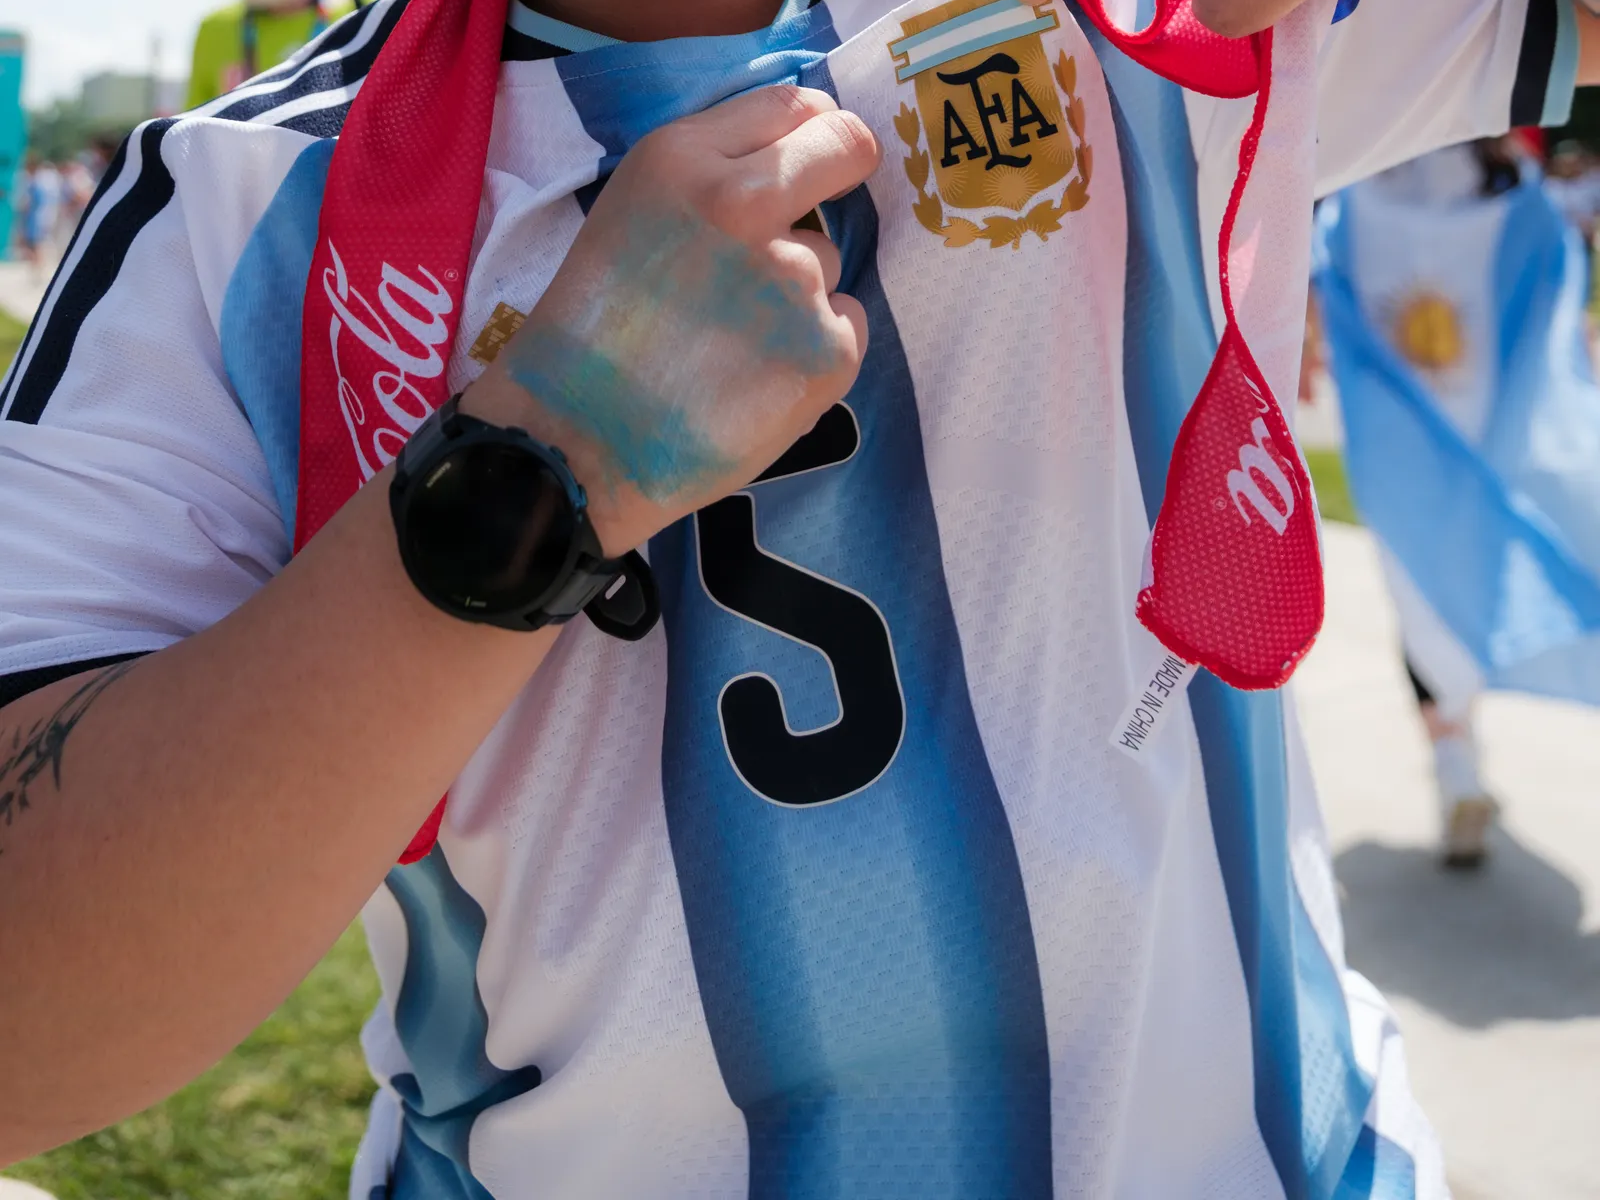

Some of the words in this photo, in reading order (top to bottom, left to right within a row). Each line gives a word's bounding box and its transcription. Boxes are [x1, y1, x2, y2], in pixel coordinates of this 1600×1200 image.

[936, 52, 1058, 171] AFA
[1148, 654, 1187, 698] MADE
[1140, 691, 1164, 714] IN
[1118, 707, 1155, 751] CHINA
